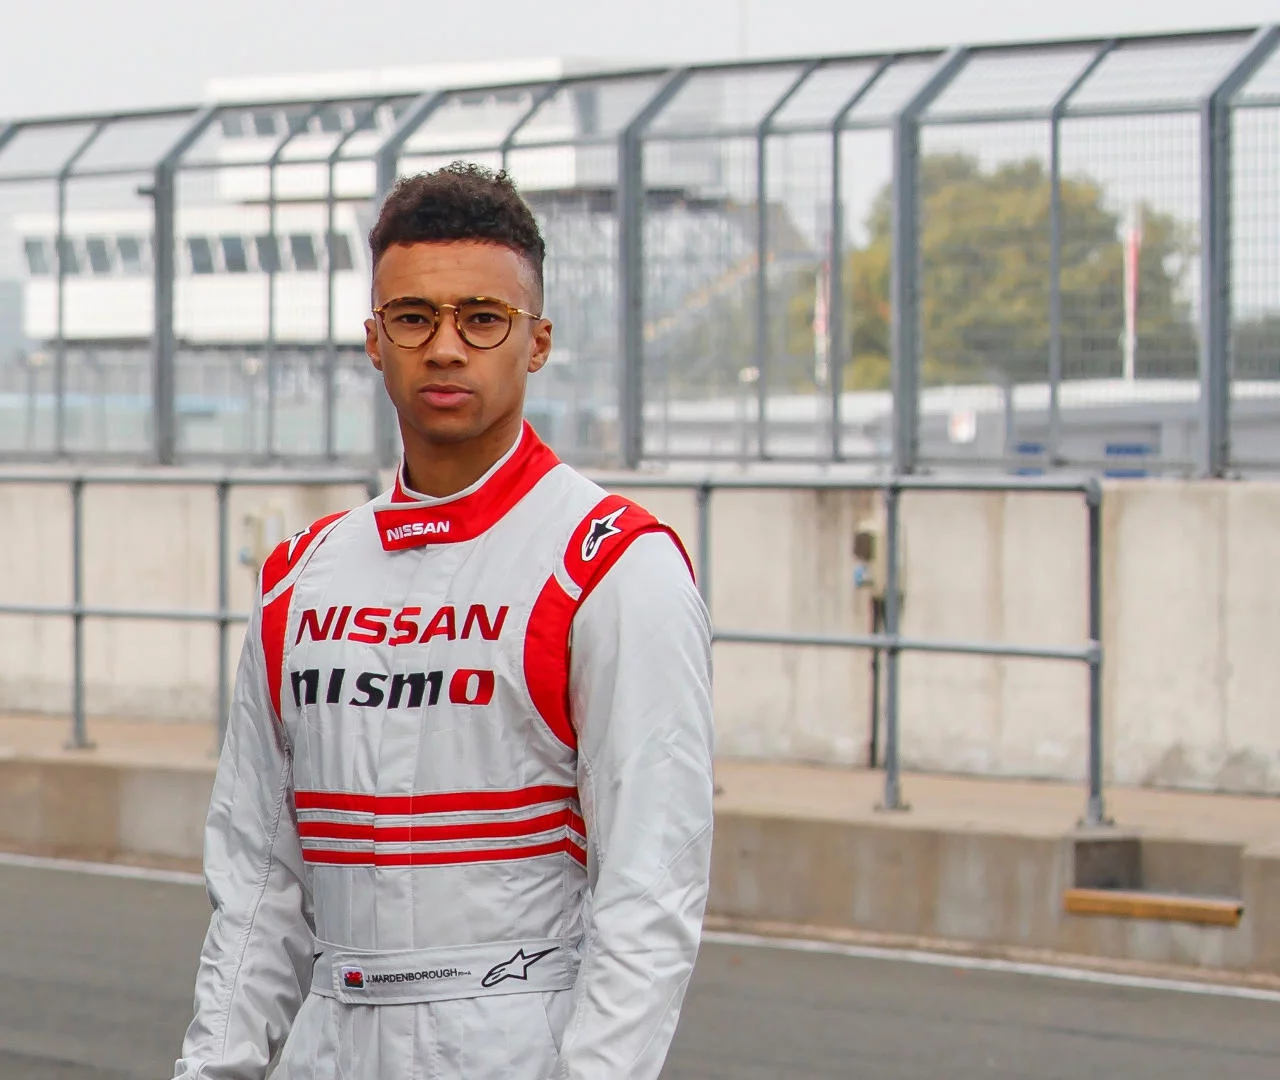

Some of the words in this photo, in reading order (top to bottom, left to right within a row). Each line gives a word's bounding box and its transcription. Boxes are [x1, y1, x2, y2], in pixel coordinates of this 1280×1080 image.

[386, 520, 450, 541] NISSAN
[295, 604, 509, 646] NISSAN
[291, 668, 495, 709] nismo
[365, 968, 458, 983] J.MARDENBOROUGH
